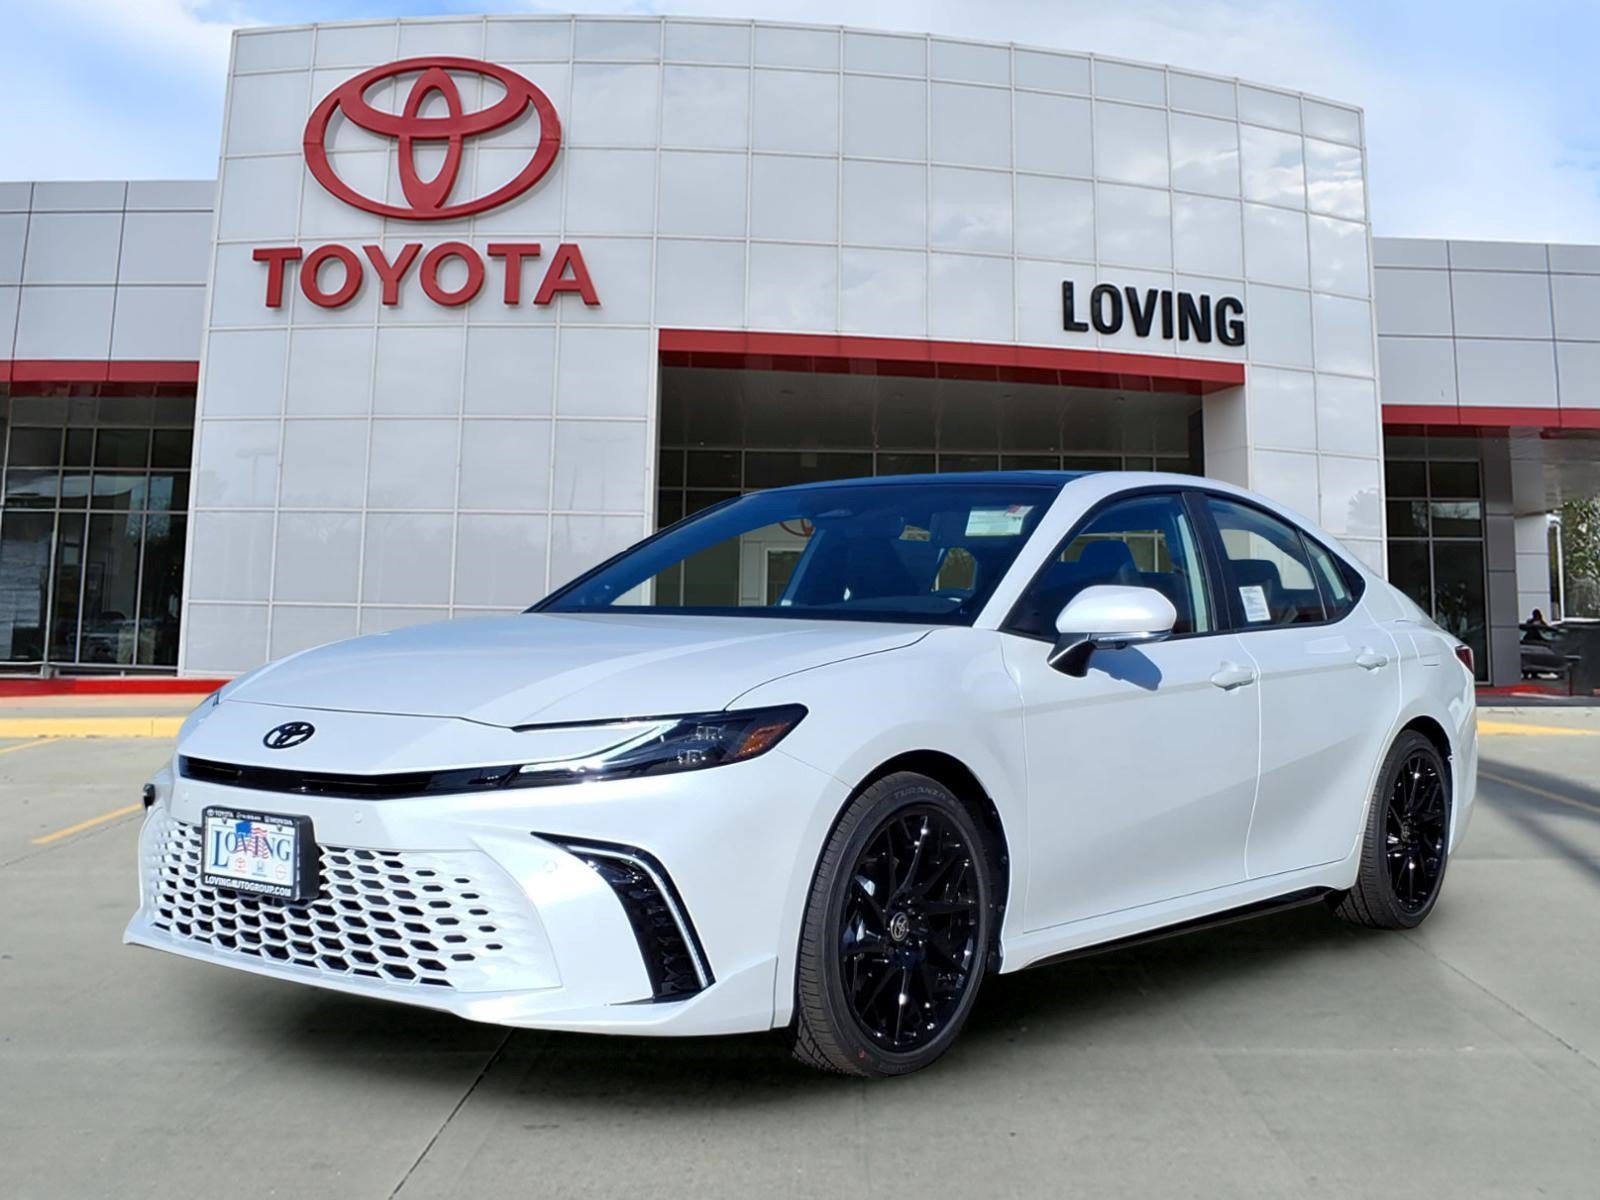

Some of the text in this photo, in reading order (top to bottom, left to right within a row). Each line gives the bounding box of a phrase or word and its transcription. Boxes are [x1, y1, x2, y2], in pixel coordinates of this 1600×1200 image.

[253, 241, 601, 308] TOYOTA
[1062, 280, 1245, 347] LOVING
[212, 831, 291, 868] LOVING
[205, 875, 291, 897] LOVINGAUTOGROUP.COM
